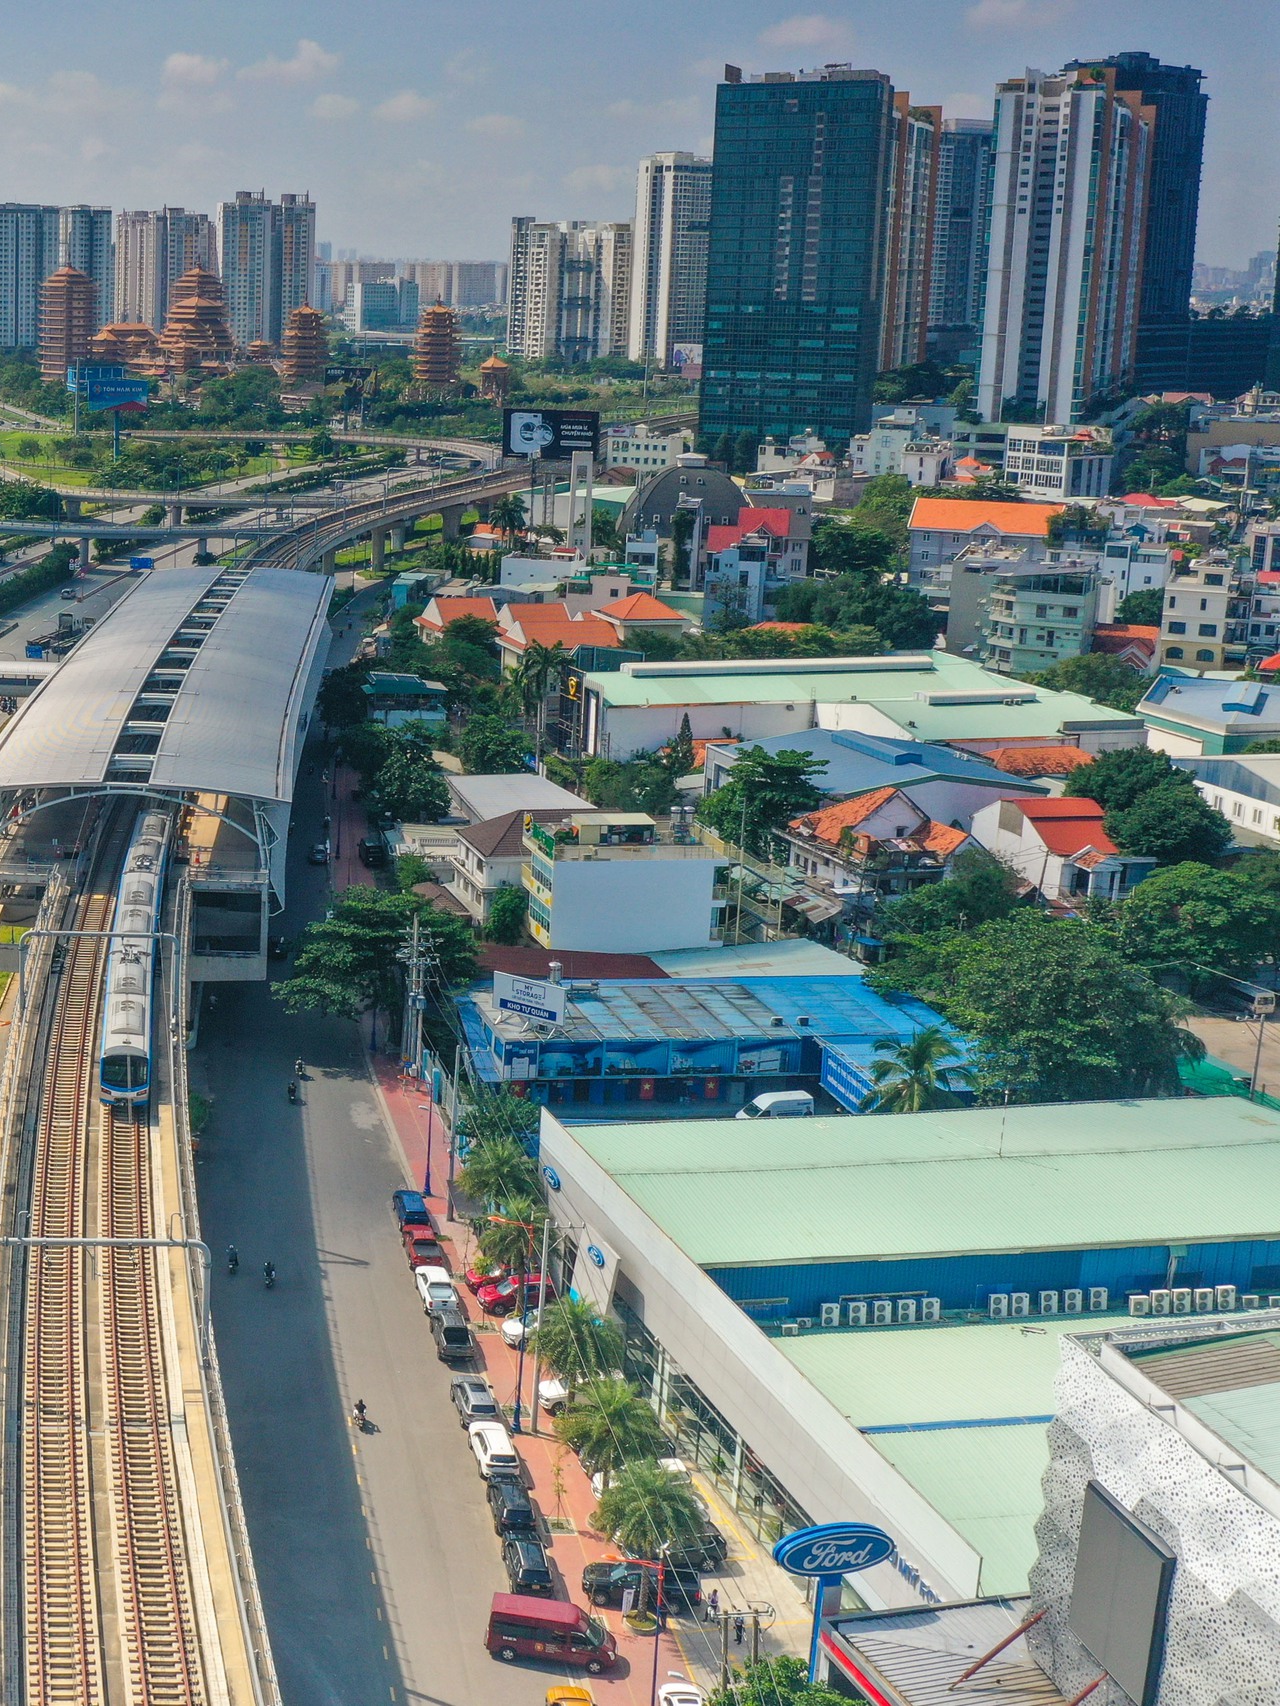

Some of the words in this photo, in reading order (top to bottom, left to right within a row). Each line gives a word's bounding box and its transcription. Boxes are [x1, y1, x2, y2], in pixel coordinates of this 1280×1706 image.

[515, 989, 542, 1000] STORAGE
[507, 1002, 520, 1010] KHO
[802, 1538, 873, 1570] Ford
